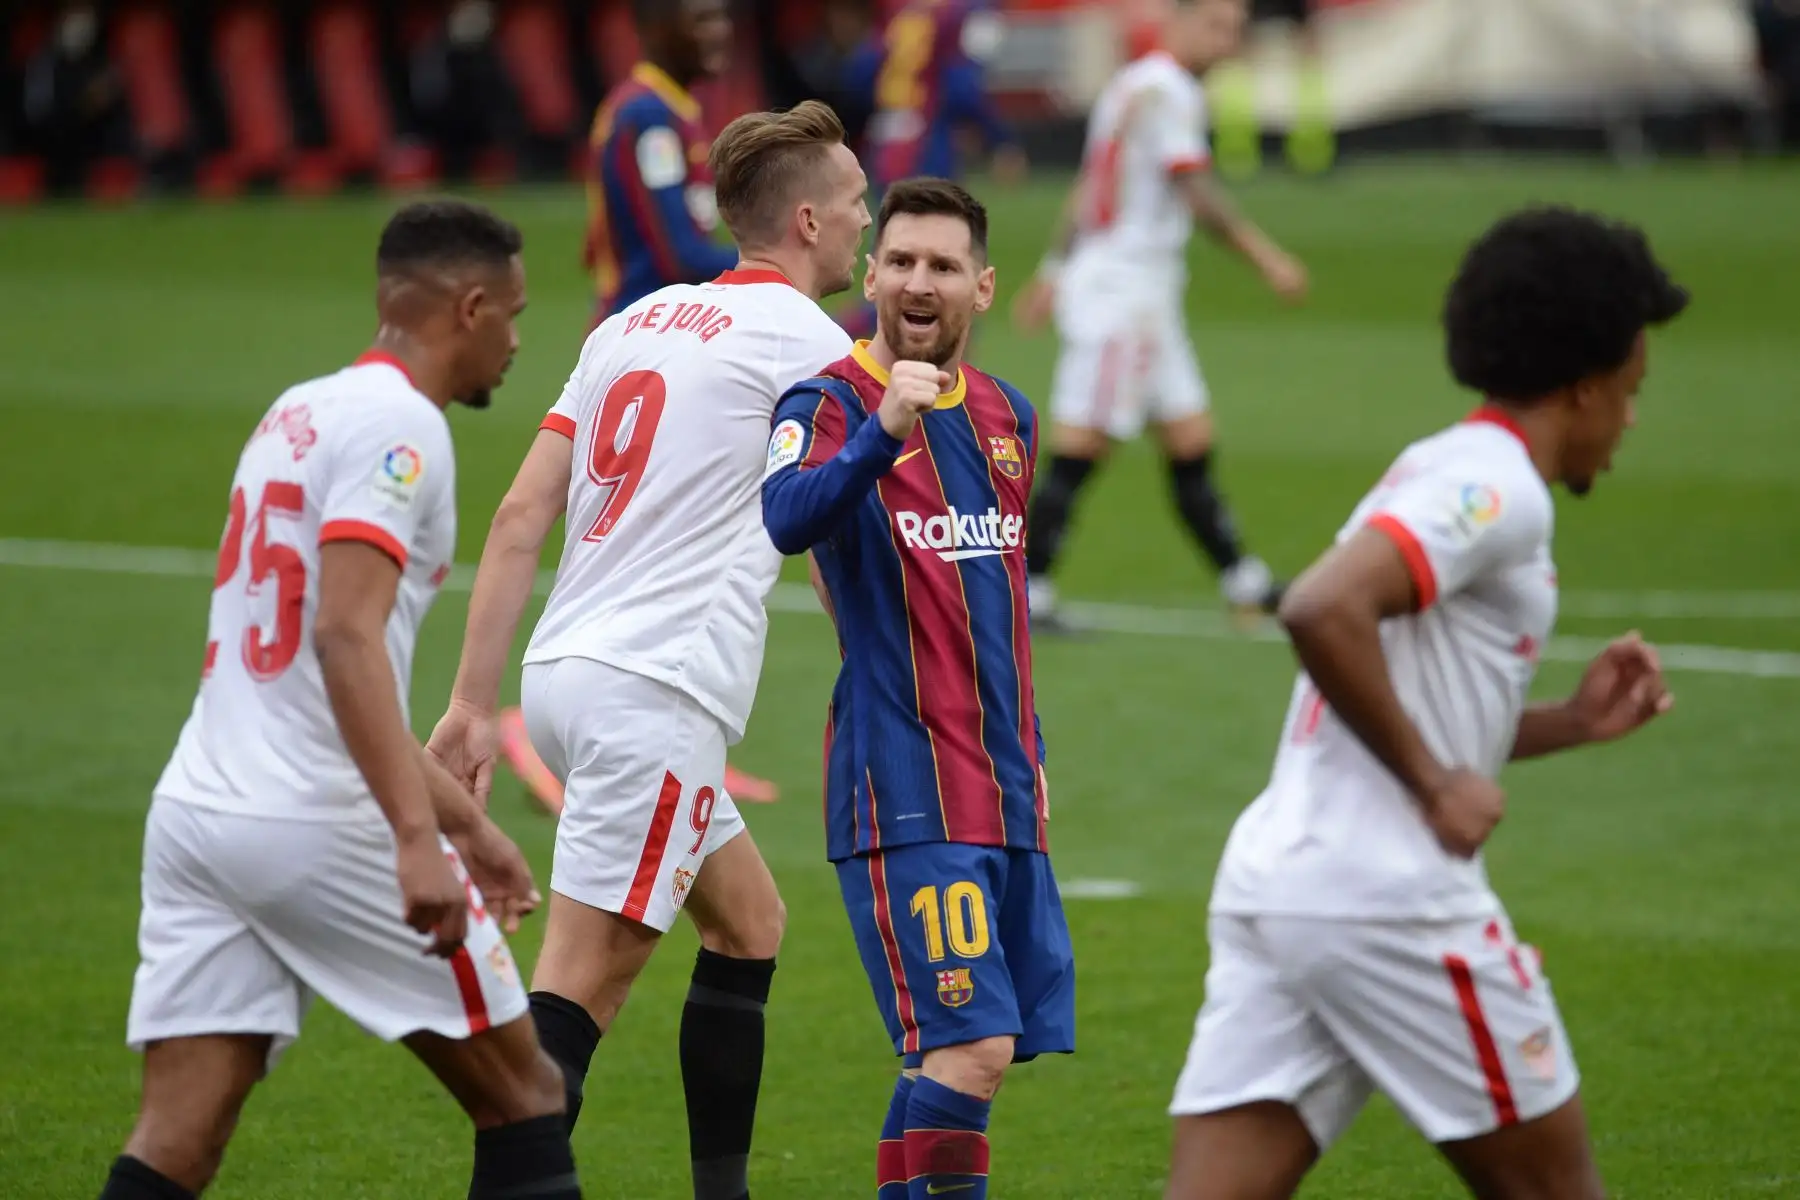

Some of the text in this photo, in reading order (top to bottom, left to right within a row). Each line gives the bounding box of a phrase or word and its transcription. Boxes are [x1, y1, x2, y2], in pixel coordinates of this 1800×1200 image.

[622, 302, 734, 344] DE JONG
[581, 368, 667, 543] 9
[687, 785, 716, 857] 9
[909, 880, 991, 963] 10
